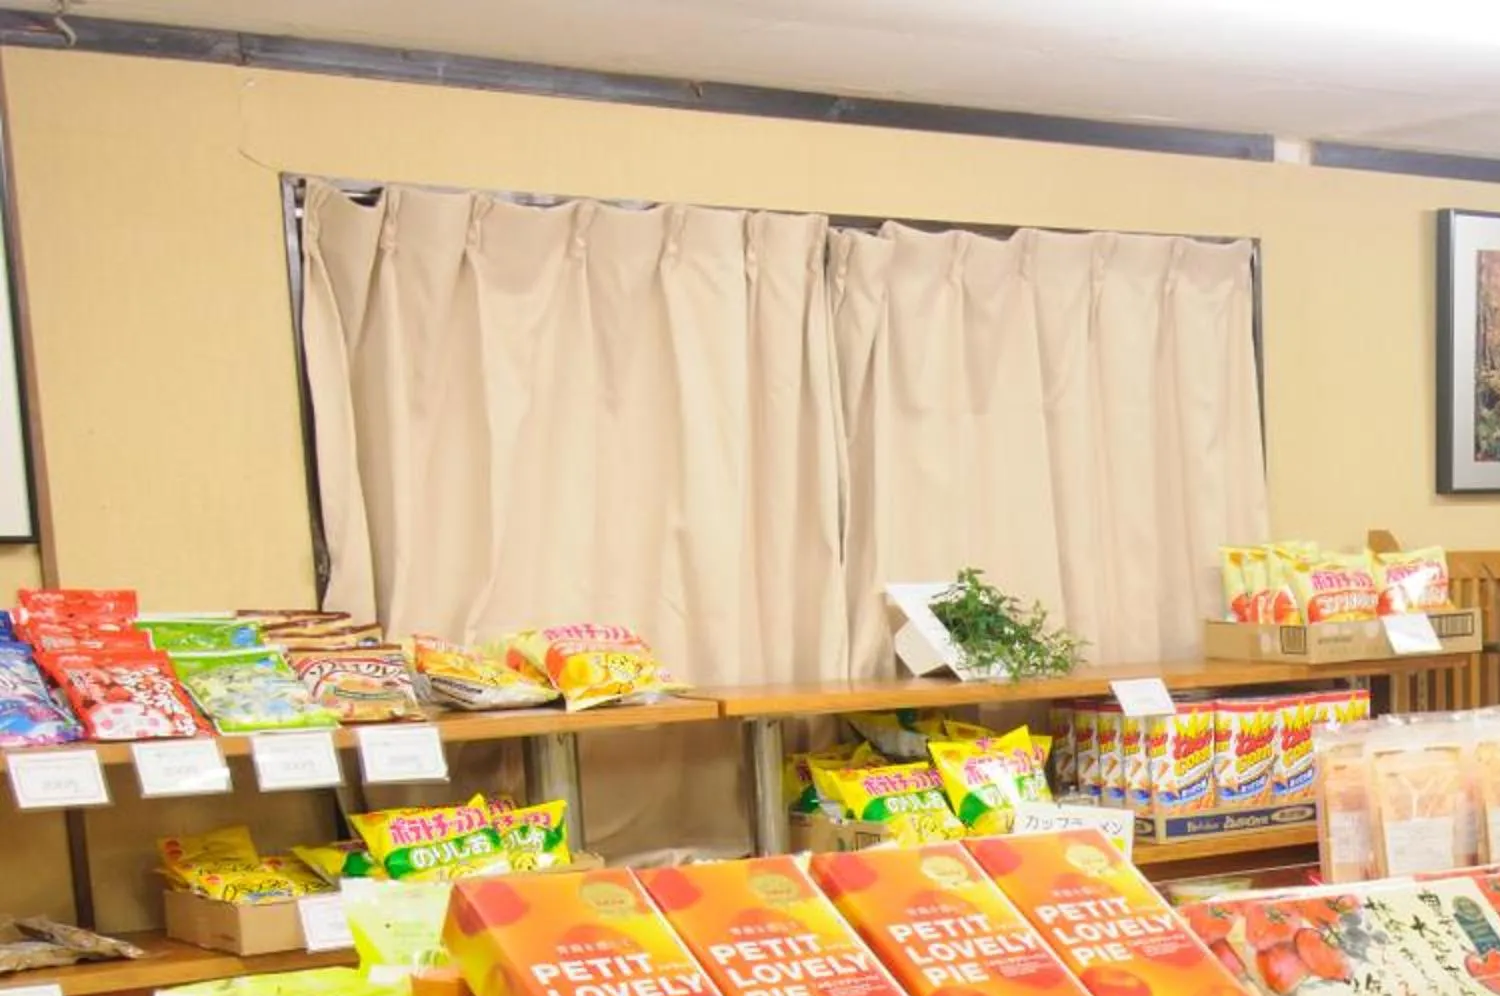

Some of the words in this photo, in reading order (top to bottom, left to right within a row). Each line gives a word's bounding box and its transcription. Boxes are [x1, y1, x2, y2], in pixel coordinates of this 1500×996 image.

[409, 831, 491, 869] のりしお
[1034, 895, 1132, 925] PETIT
[887, 912, 994, 943] PETIT
[1051, 912, 1176, 946] LOVELY
[709, 932, 823, 965] PETIT
[905, 931, 1038, 966] LOVELY
[1070, 941, 1134, 967] PIE
[530, 952, 653, 986] PETIT
[725, 951, 872, 989] LOVELY
[921, 961, 991, 988] PIE
